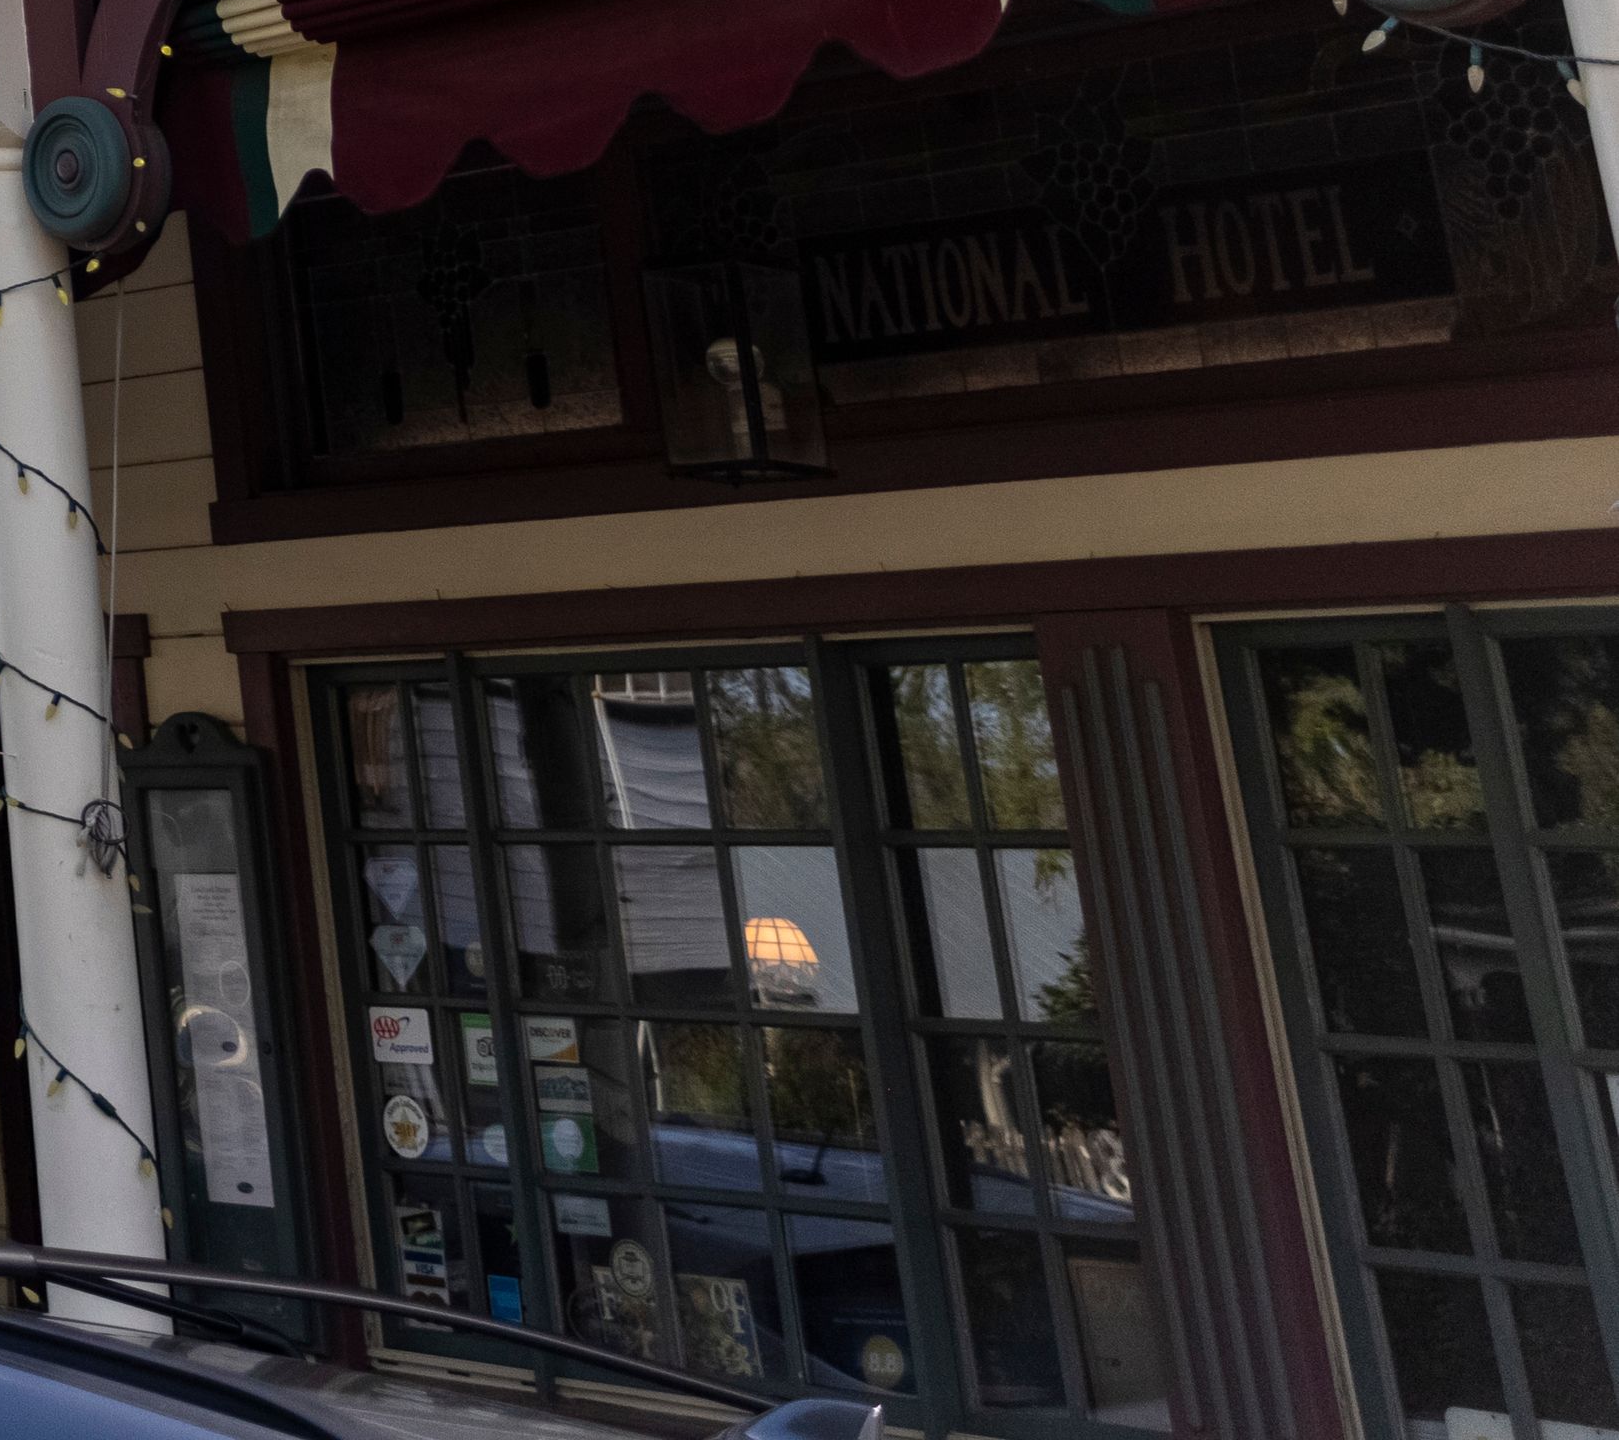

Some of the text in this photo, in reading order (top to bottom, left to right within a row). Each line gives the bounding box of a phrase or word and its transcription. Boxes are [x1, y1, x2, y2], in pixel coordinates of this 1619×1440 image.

[814, 185, 1376, 343] NATIONAL HOTEL
[529, 1026, 572, 1038] DISCOVER
[389, 1042, 430, 1055] Approved
[415, 1262, 436, 1275] VISA
